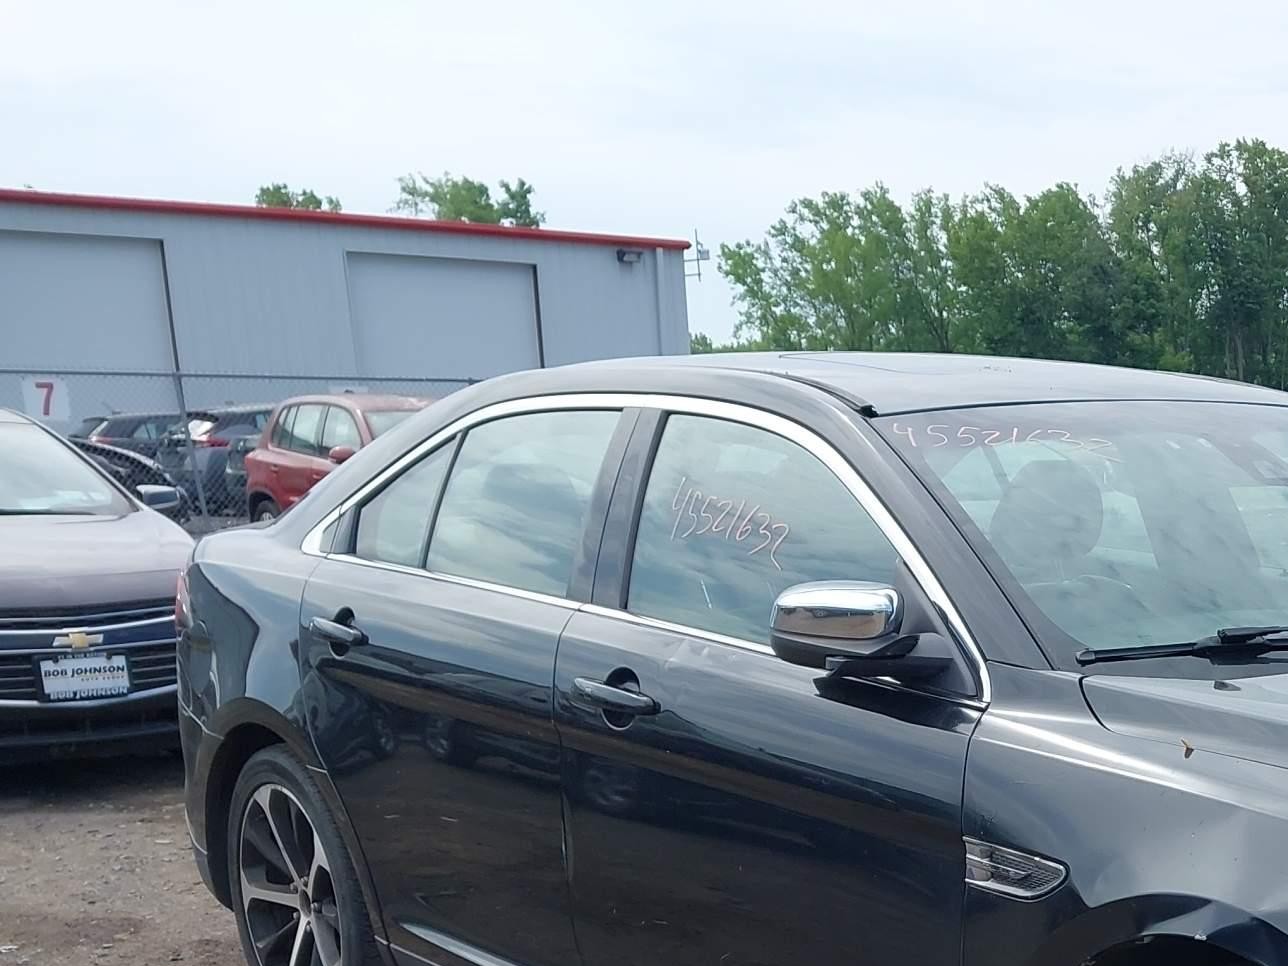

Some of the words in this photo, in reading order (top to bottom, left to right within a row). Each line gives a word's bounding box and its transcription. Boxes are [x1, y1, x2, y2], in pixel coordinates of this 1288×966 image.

[35, 382, 54, 416] 7
[893, 422, 1122, 463] 45521632
[670, 476, 790, 571] 45521632
[44, 669, 68, 677] BOB
[71, 665, 125, 678] JOHNSON
